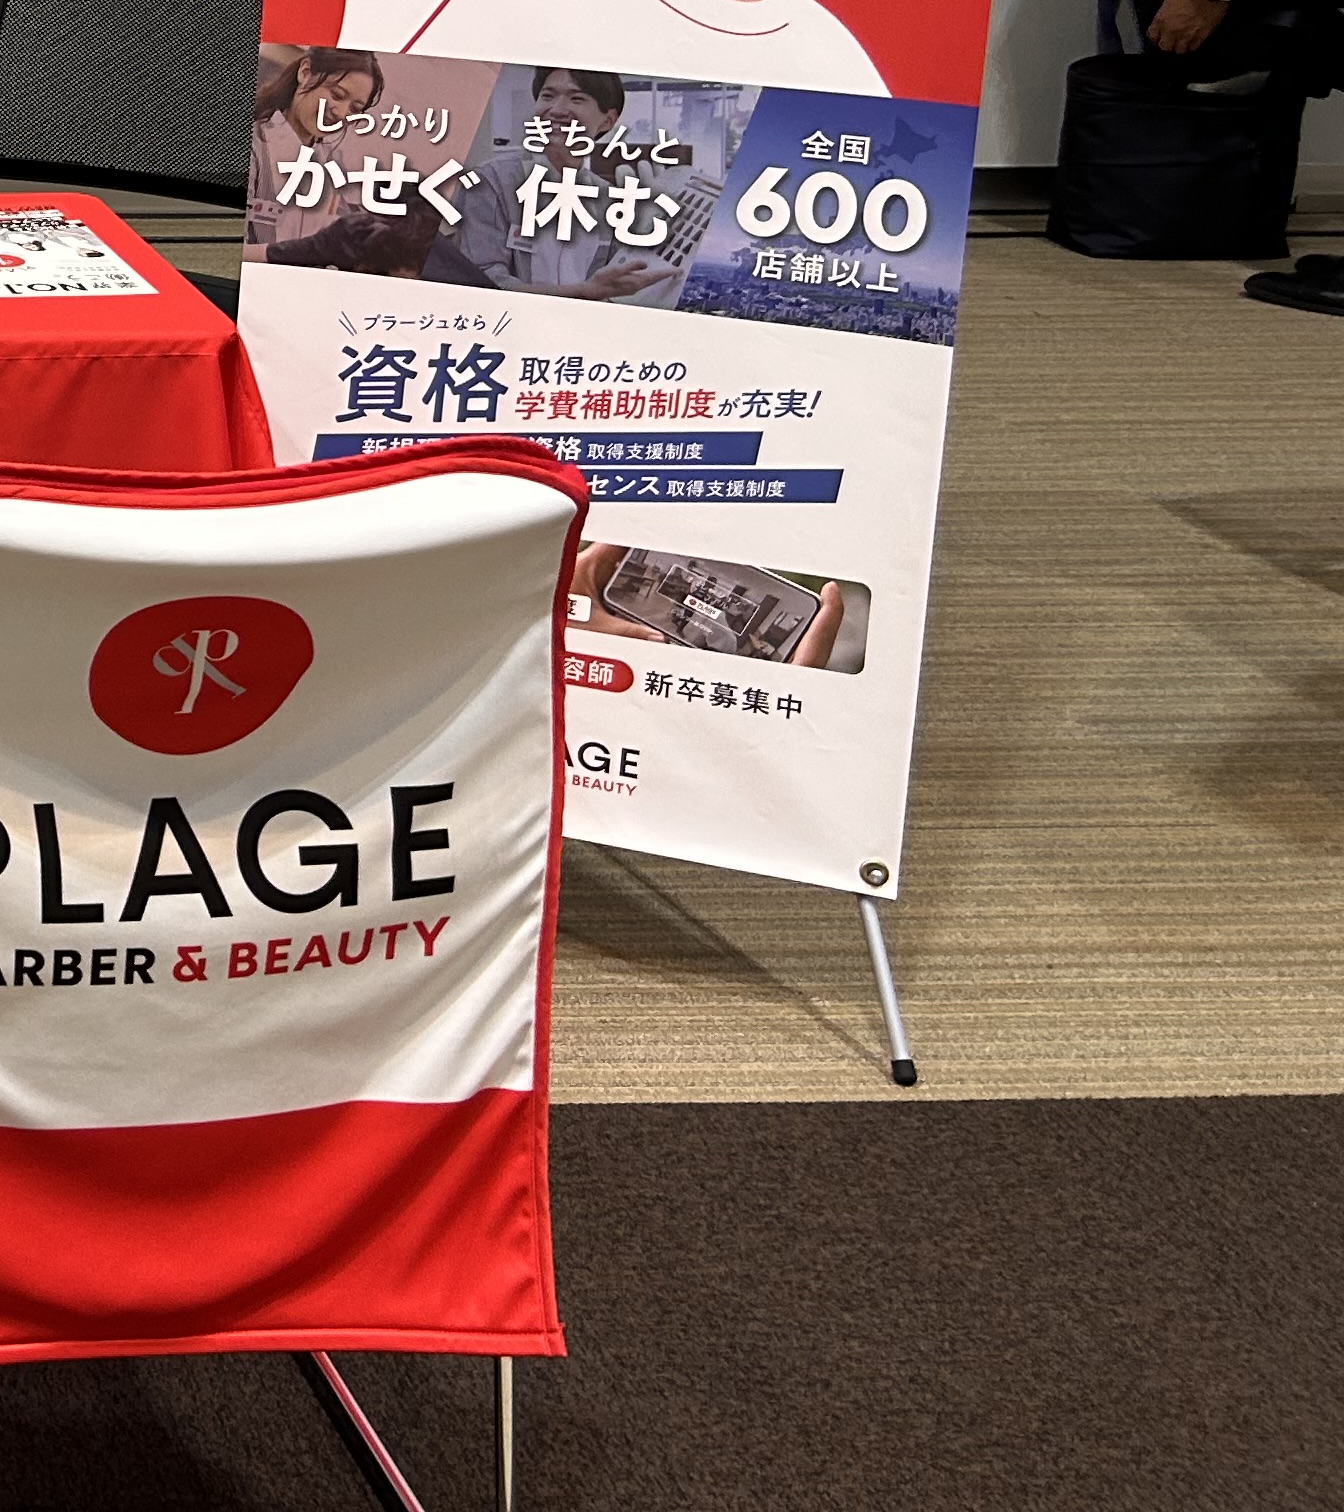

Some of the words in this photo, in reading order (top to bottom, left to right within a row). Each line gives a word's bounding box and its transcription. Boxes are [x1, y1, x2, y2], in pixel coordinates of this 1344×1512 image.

[316, 98, 450, 144] しっかり
[522, 116, 680, 166] きちんと
[801, 130, 872, 165] 全国
[275, 145, 481, 226] かせぐ
[516, 164, 682, 248] 休む
[736, 166, 928, 253] 600
[752, 250, 899, 294] 店舗以上
[362, 314, 487, 333] プラージュなら
[335, 343, 510, 424] 資格
[518, 356, 687, 386] 取得のための
[514, 389, 823, 421] 学費補助制度が充実!
[587, 442, 704, 461] 取得支援制度
[666, 479, 787, 499] 取得支援制度
[644, 670, 804, 720] 新卒募集中
[572, 774, 638, 797] BEAUTY
[172, 945, 209, 983] &
[227, 916, 450, 980] BEAUTY
